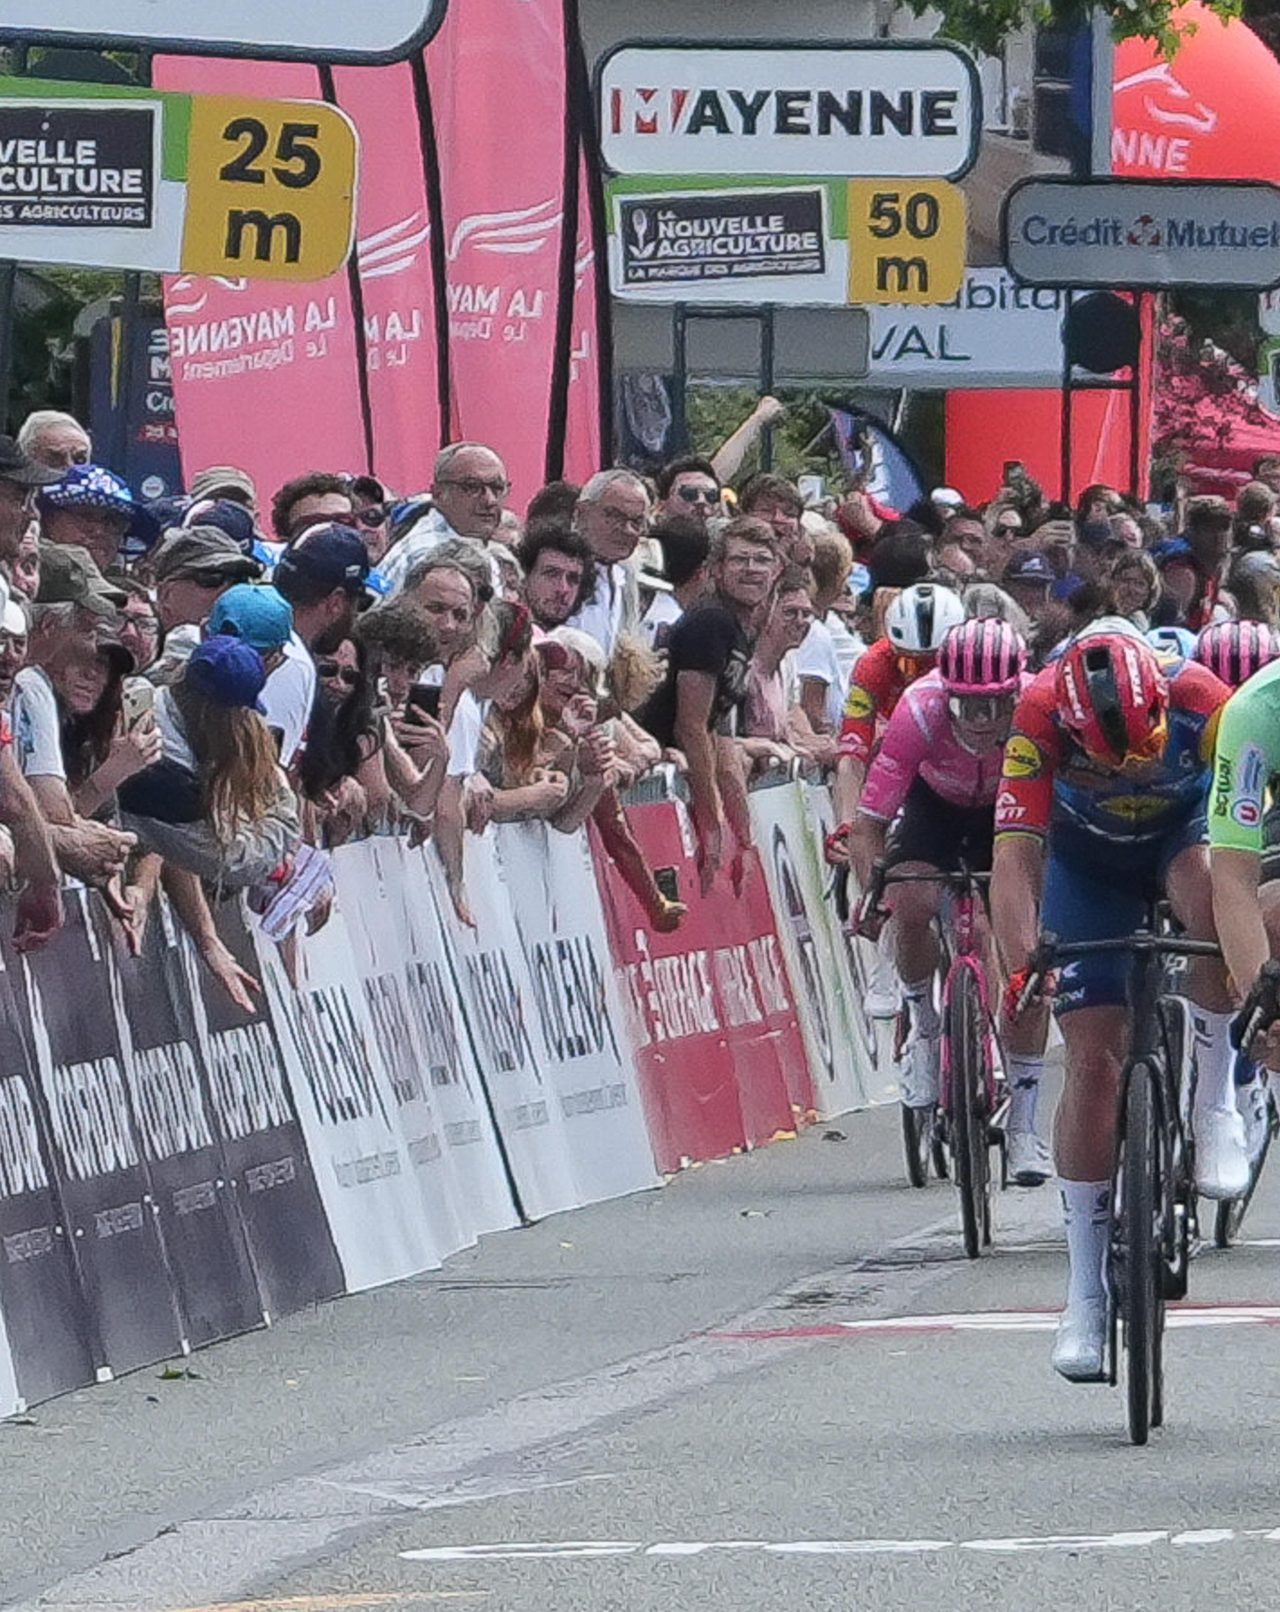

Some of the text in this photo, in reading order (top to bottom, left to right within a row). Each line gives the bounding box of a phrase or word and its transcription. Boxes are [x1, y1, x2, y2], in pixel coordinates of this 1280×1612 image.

[610, 88, 959, 135] MAYENNE
[219, 118, 321, 188] 25
[20, 204, 145, 221] AGRICULTEURS
[658, 214, 785, 240] NOUVELLE
[868, 192, 939, 239] 50
[1021, 215, 1280, 248] Crédit Mutuel
[224, 209, 301, 264] m
[656, 231, 819, 258] AGRICULTURE
[876, 255, 929, 293] m
